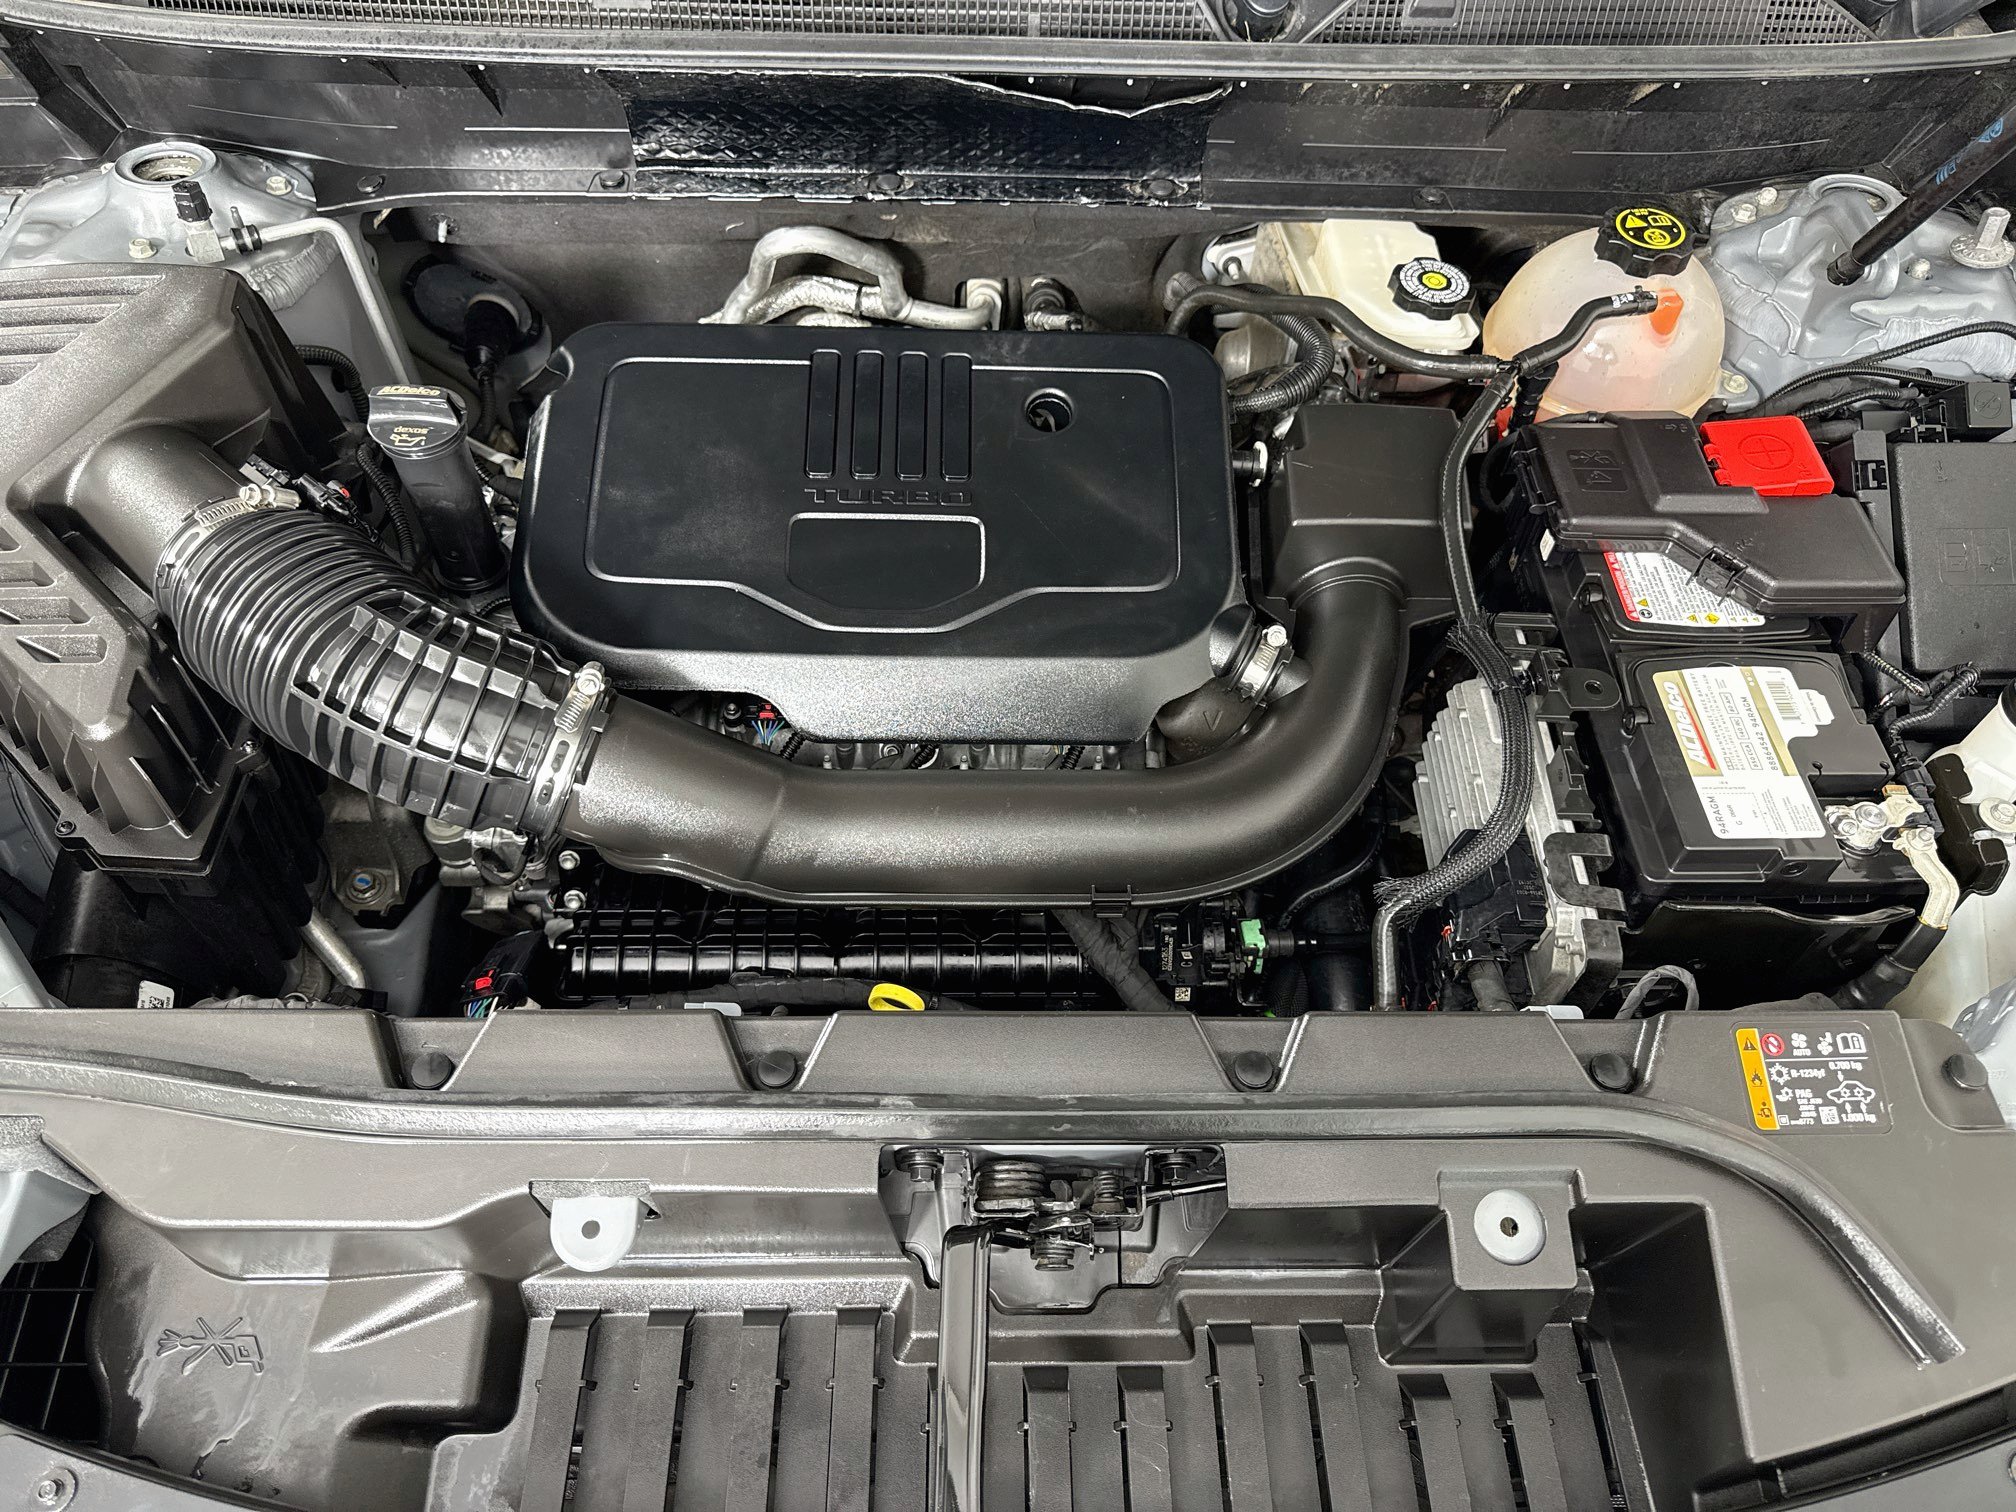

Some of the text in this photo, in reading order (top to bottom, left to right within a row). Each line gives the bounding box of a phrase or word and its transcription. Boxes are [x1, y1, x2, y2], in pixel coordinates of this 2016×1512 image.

[376, 386, 441, 396] ACDelco
[393, 426, 429, 434] dexos
[804, 487, 972, 507] TURBO
[1740, 696, 1760, 727] 94RAGM
[1663, 682, 1708, 767] ACDelco
[1706, 796, 1729, 834] 94RAGM
[1792, 1048, 1812, 1056] AUTO
[1850, 1060, 1863, 1071] kg
[1790, 1068, 1826, 1079] R-1234yf
[1795, 1089, 1813, 1098] PAG
[1864, 1112, 1877, 1123] kg
